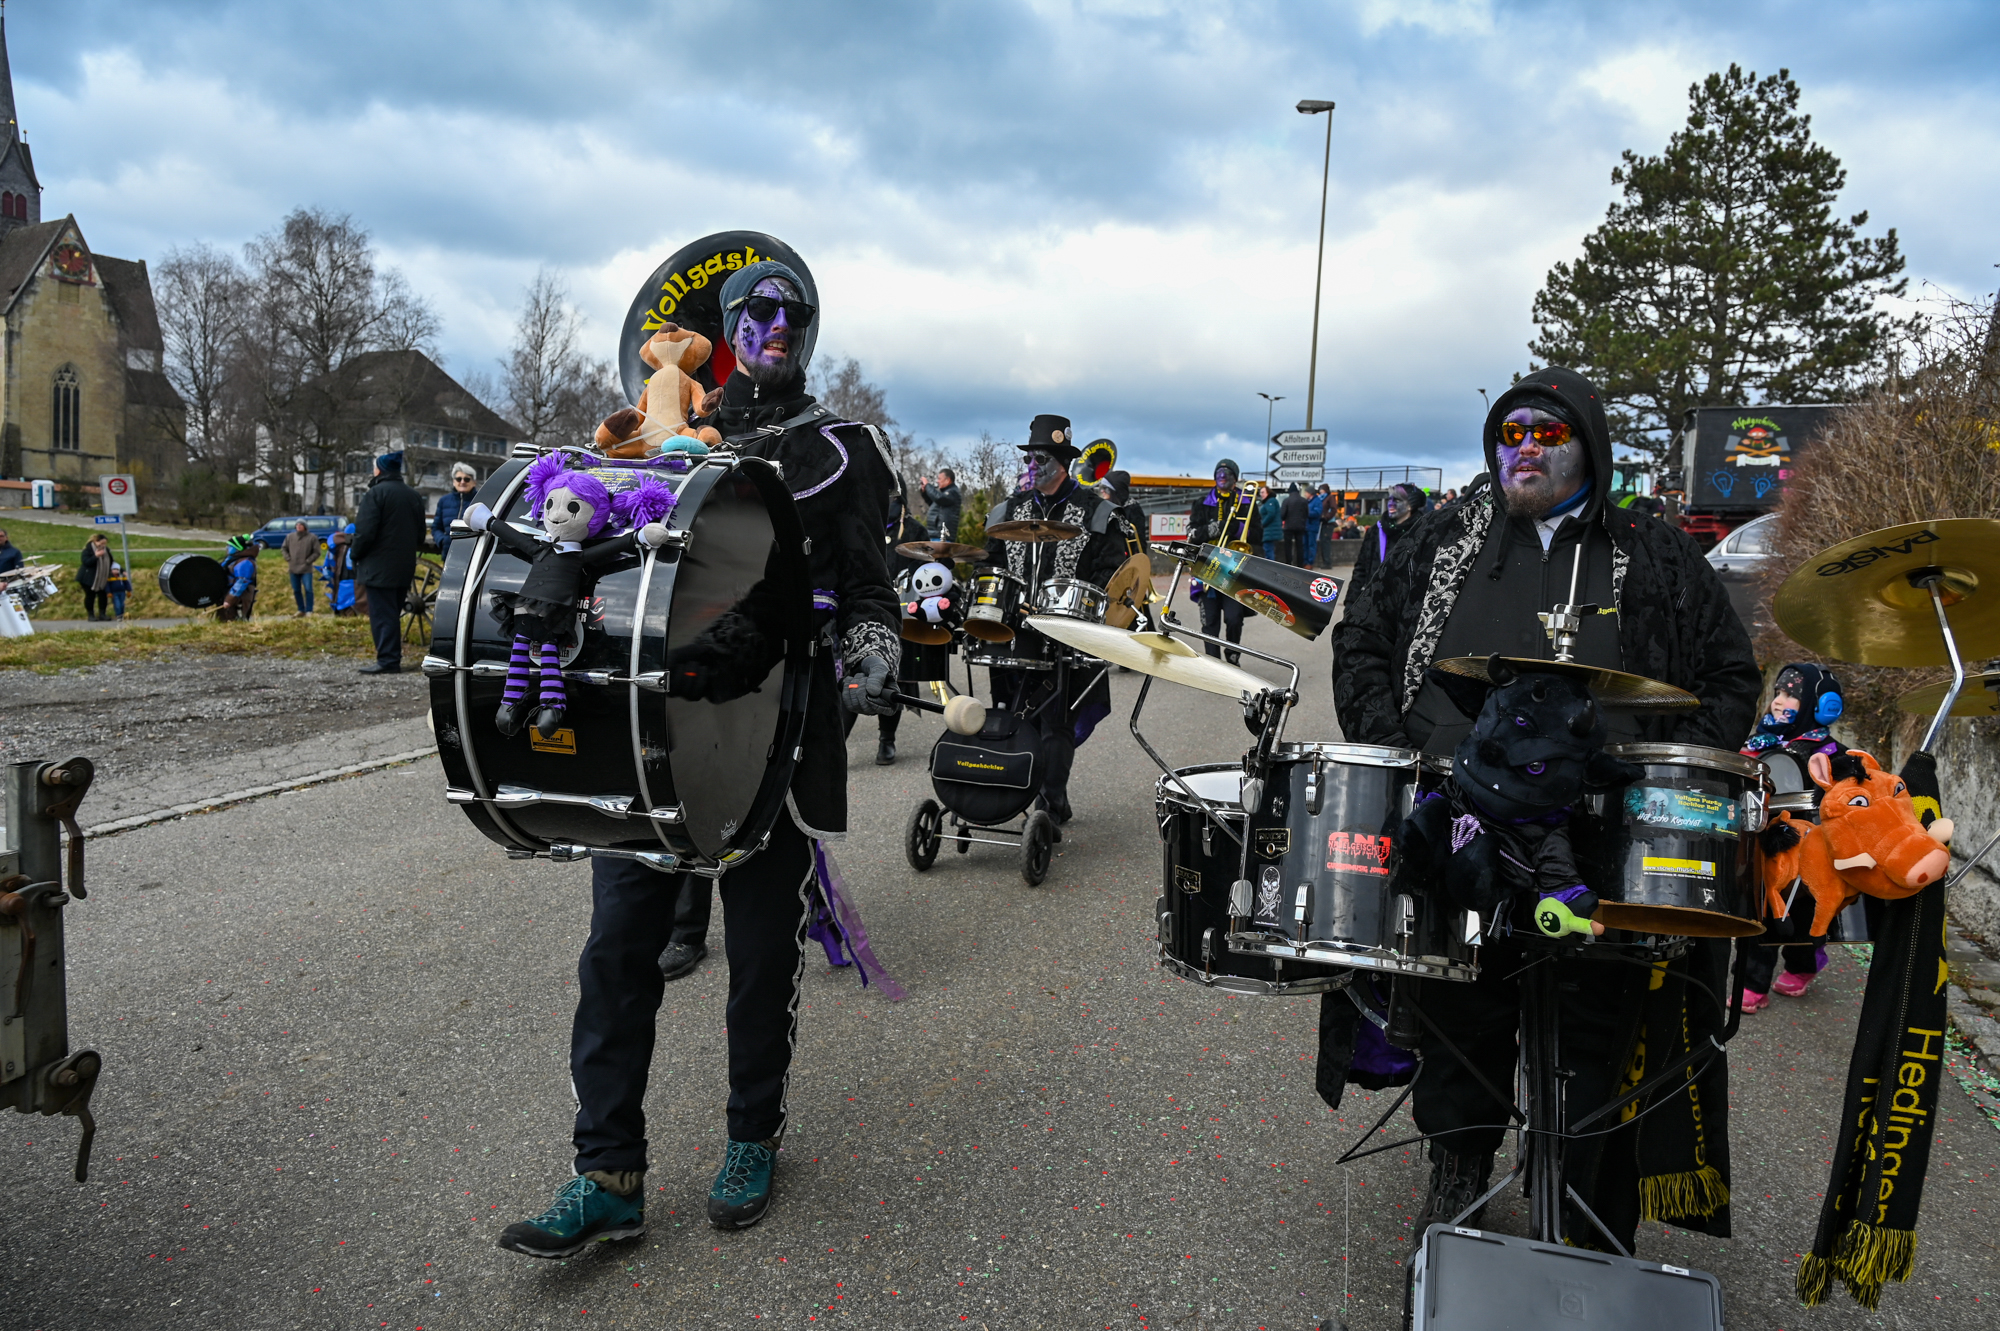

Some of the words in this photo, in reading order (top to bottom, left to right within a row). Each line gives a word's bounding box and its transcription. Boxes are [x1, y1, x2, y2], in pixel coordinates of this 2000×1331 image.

[1283, 434, 1310, 444] Affoltern
[1311, 434, 1323, 443] a.A.
[1282, 451, 1322, 462] Rifferswil
[1280, 469, 1300, 478] Kloster
[1301, 469, 1321, 479] Kappel
[1674, 793, 1701, 803] Vollgas
[1701, 797, 1723, 808] Party
[1706, 804, 1720, 812] Ball
